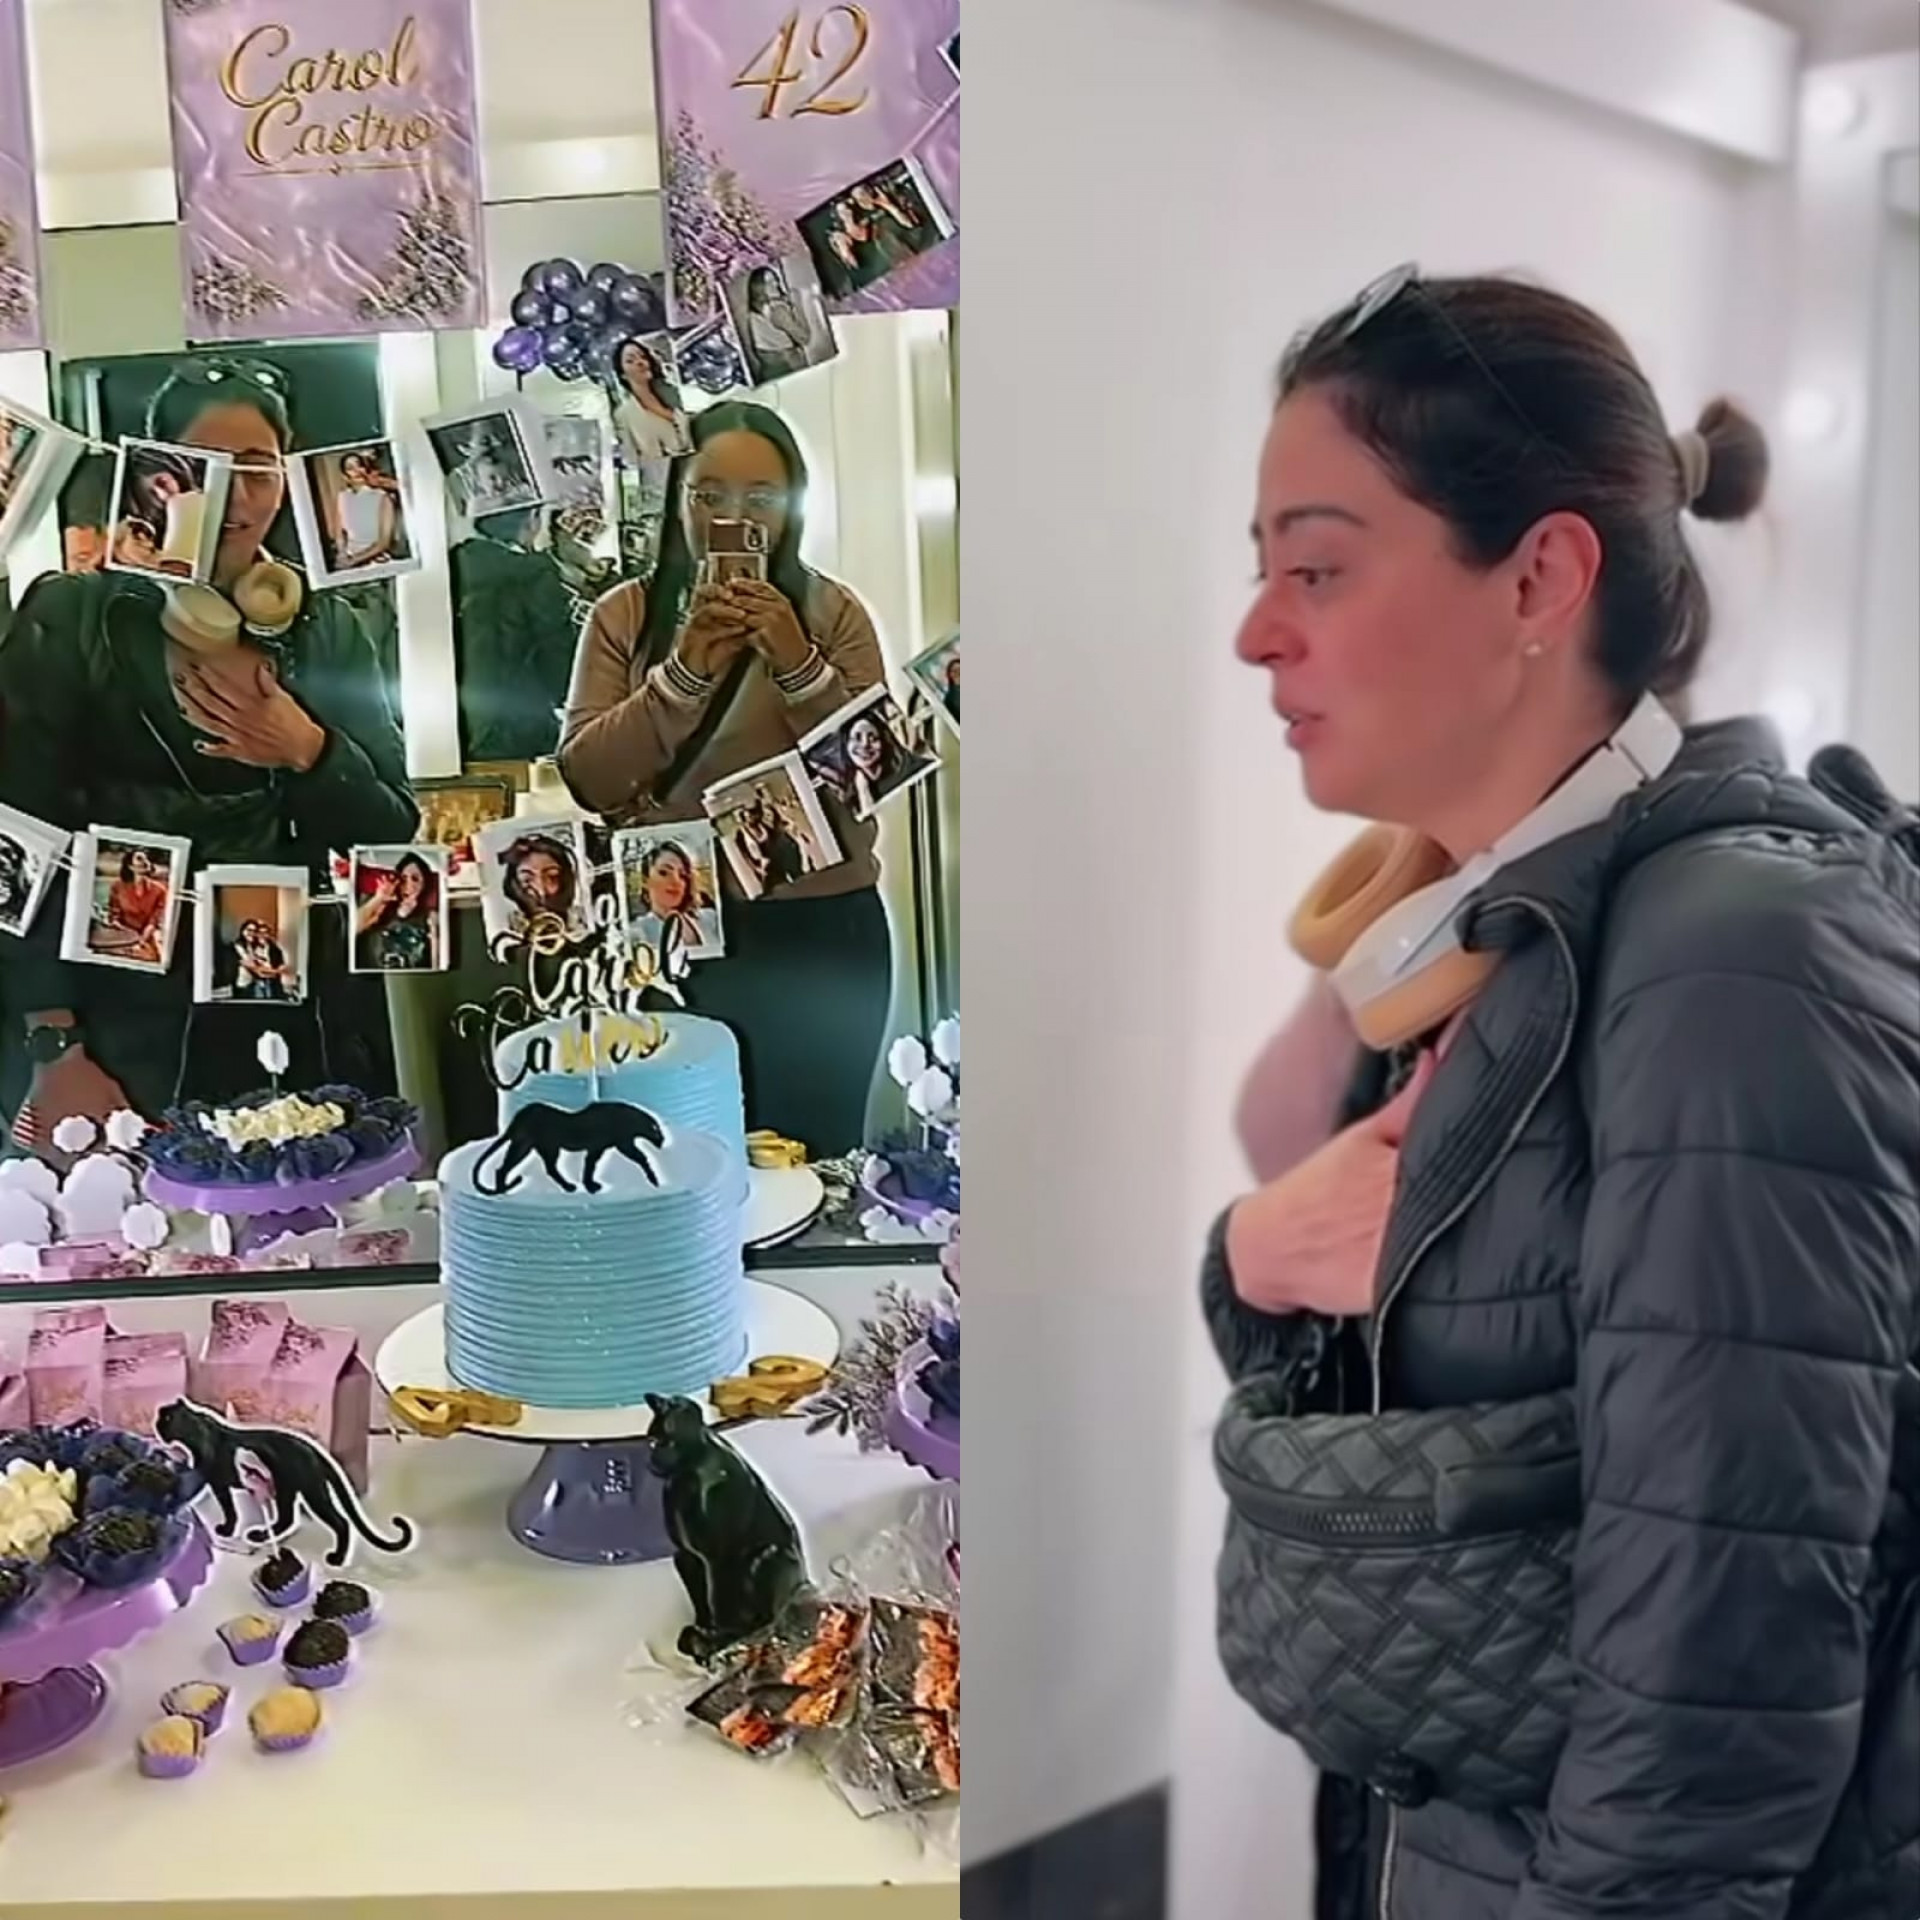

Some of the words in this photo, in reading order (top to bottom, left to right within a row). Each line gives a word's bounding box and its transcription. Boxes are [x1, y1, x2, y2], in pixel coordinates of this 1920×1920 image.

[221, 15, 418, 108] Carol
[730, 4, 869, 120] 42
[245, 97, 435, 167] Castro
